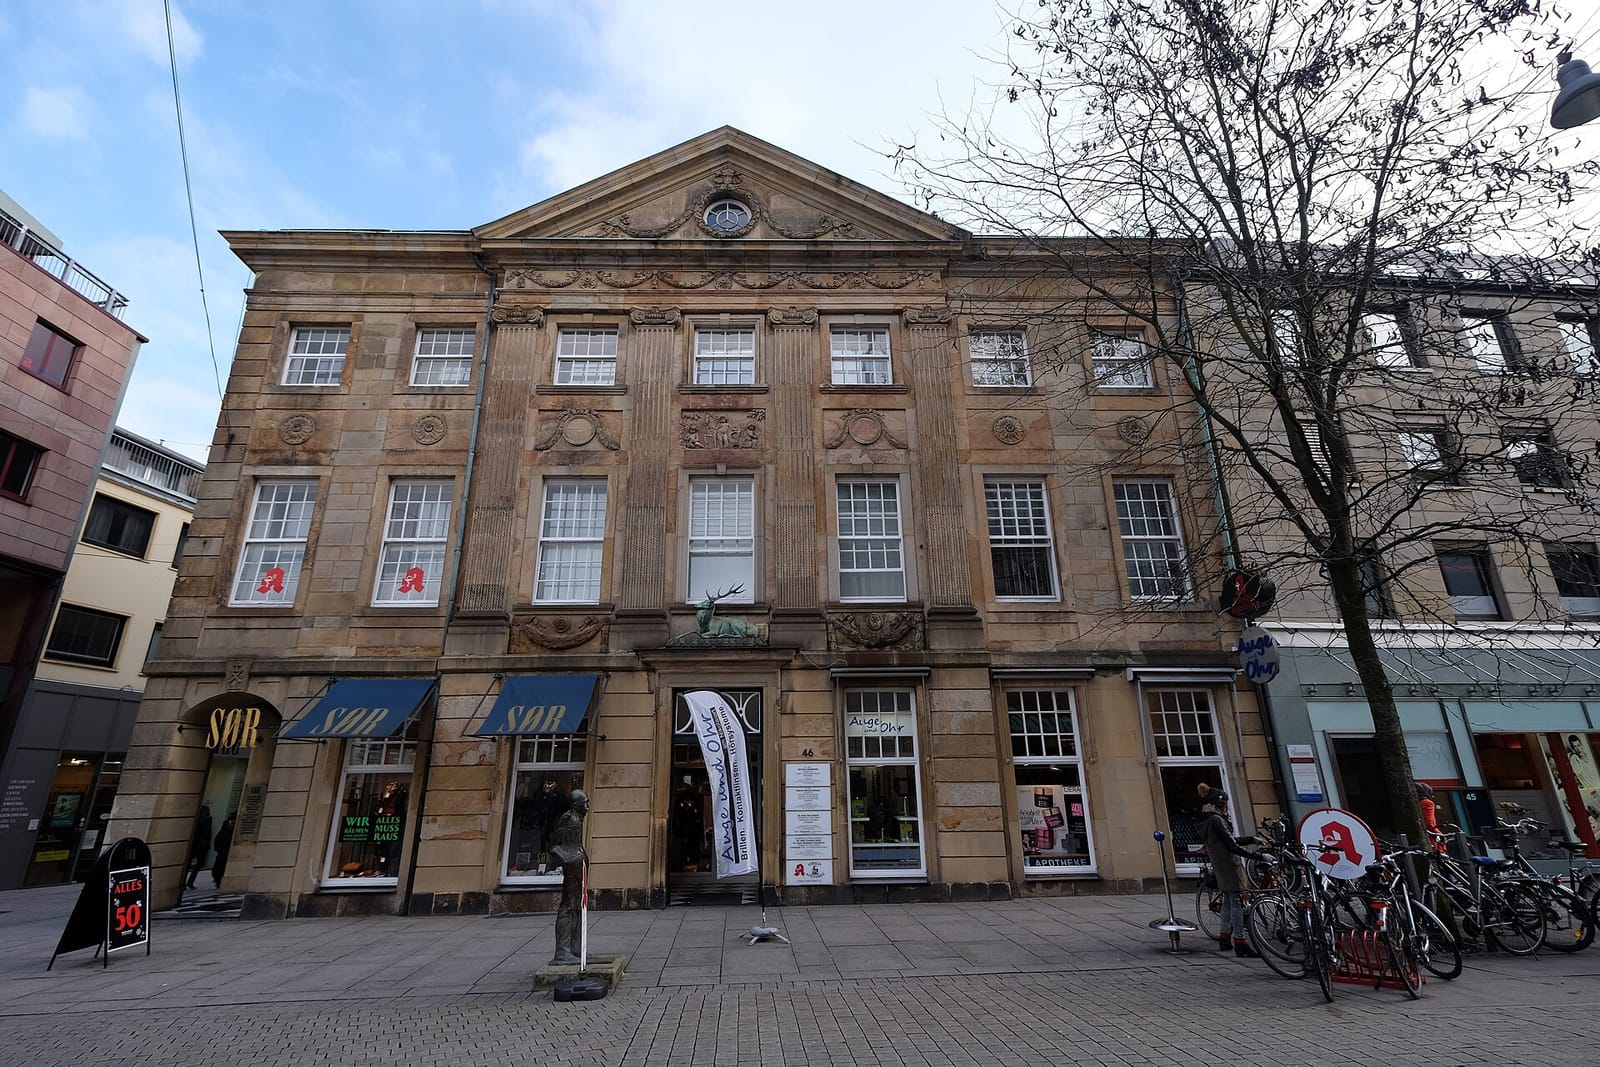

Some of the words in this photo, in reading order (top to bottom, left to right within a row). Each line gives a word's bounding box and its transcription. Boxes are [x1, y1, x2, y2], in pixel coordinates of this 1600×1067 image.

[1237, 635, 1273, 657] Auge
[1245, 659, 1276, 679] Ohr
[310, 707, 389, 735] SØR
[497, 705, 566, 732] SØR
[849, 716, 879, 728] Auge
[205, 708, 262, 749] SØR
[701, 713, 720, 752] Ohr
[880, 722, 905, 732] Ohr
[801, 748, 814, 757] 46
[711, 757, 728, 801] und
[1466, 793, 1477, 801] 45
[346, 816, 370, 826] WIR
[376, 816, 401, 824] ALLES
[375, 824, 400, 832] MUSS
[721, 807, 735, 862] Auge
[373, 832, 399, 841] RAUS
[1035, 858, 1088, 867] APOTHEKE
[114, 879, 143, 894] ALLES
[114, 904, 142, 931] 50
